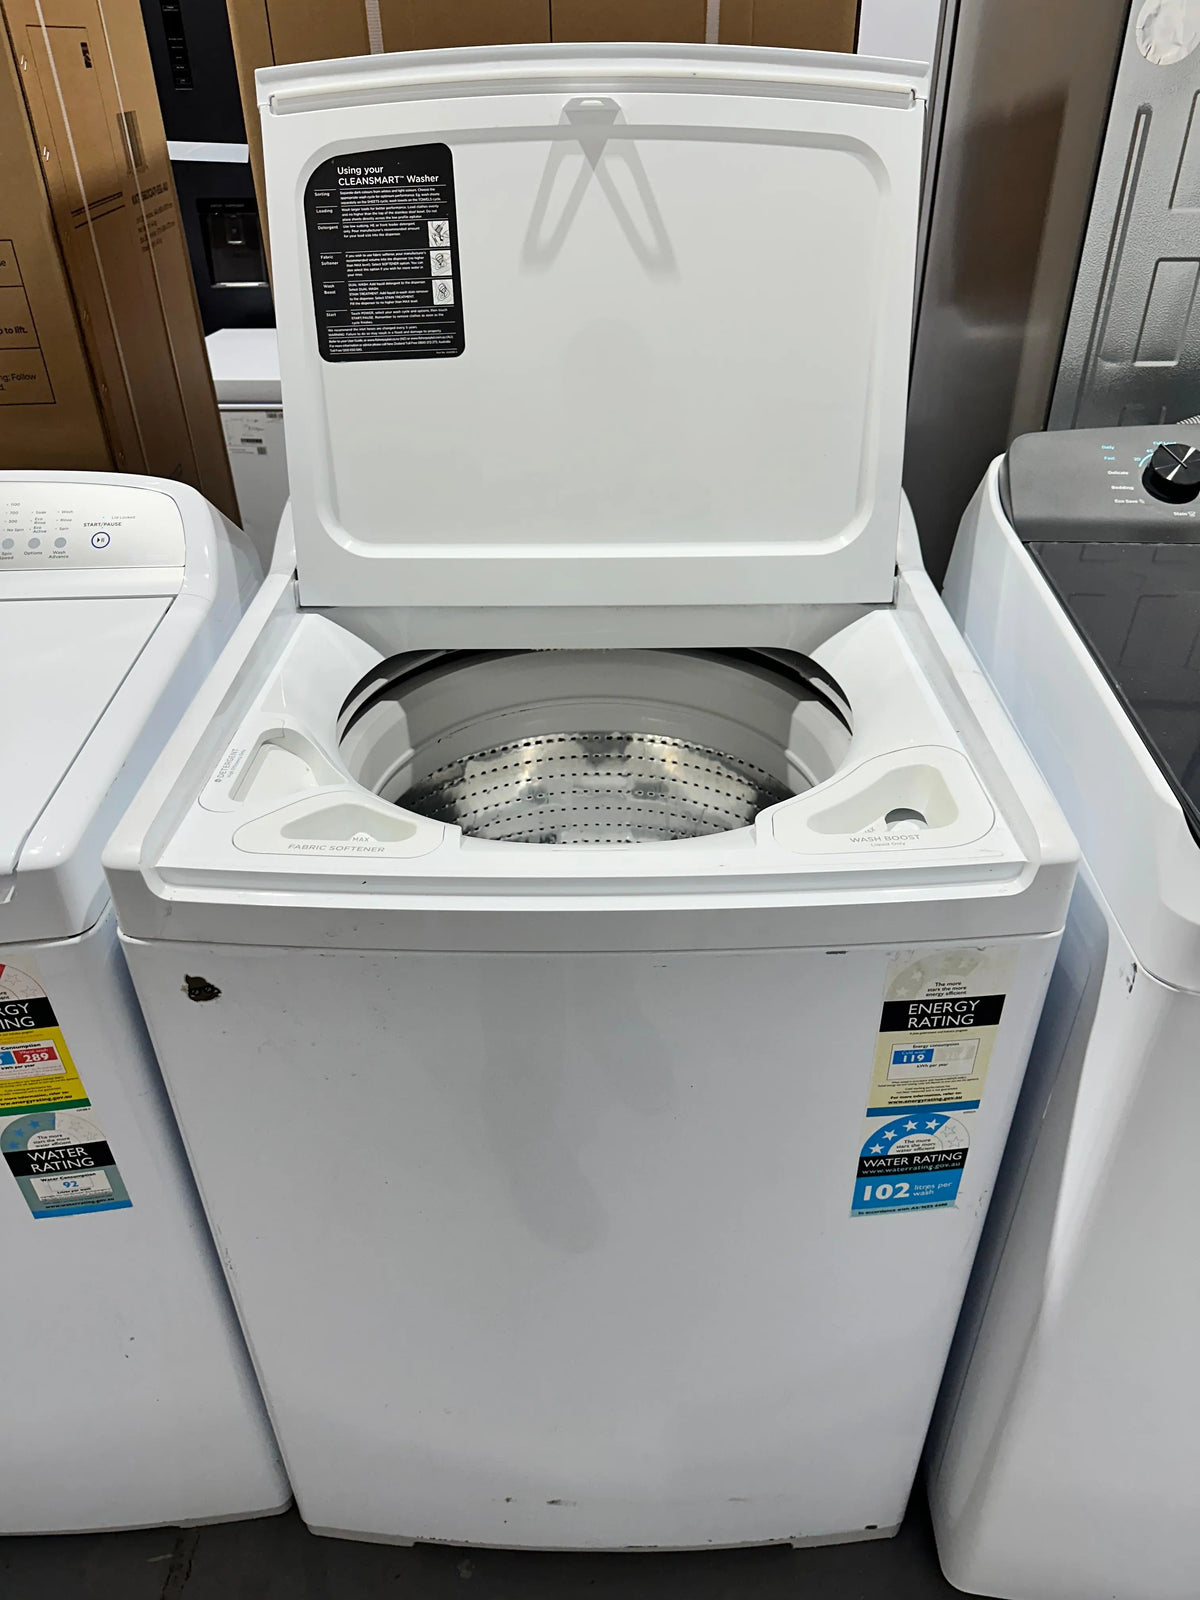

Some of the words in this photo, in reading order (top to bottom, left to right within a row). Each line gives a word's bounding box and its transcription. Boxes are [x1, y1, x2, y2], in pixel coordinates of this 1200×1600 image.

[337, 167, 361, 175] Using
[364, 166, 383, 175] your
[407, 175, 439, 183] Washer
[908, 1000, 980, 1015] ENERGY
[908, 1014, 974, 1028] RATING
[23, 1053, 49, 1063] 289
[888, 1096, 962, 1104] www.energyrating.gov.au
[27, 1147, 88, 1161] WATER
[863, 1158, 908, 1167] WATER
[913, 1152, 963, 1164] RATING
[30, 1157, 94, 1173] RATING
[862, 1162, 960, 1174] www.waterrating.gov.au
[864, 1183, 910, 1201] 102
